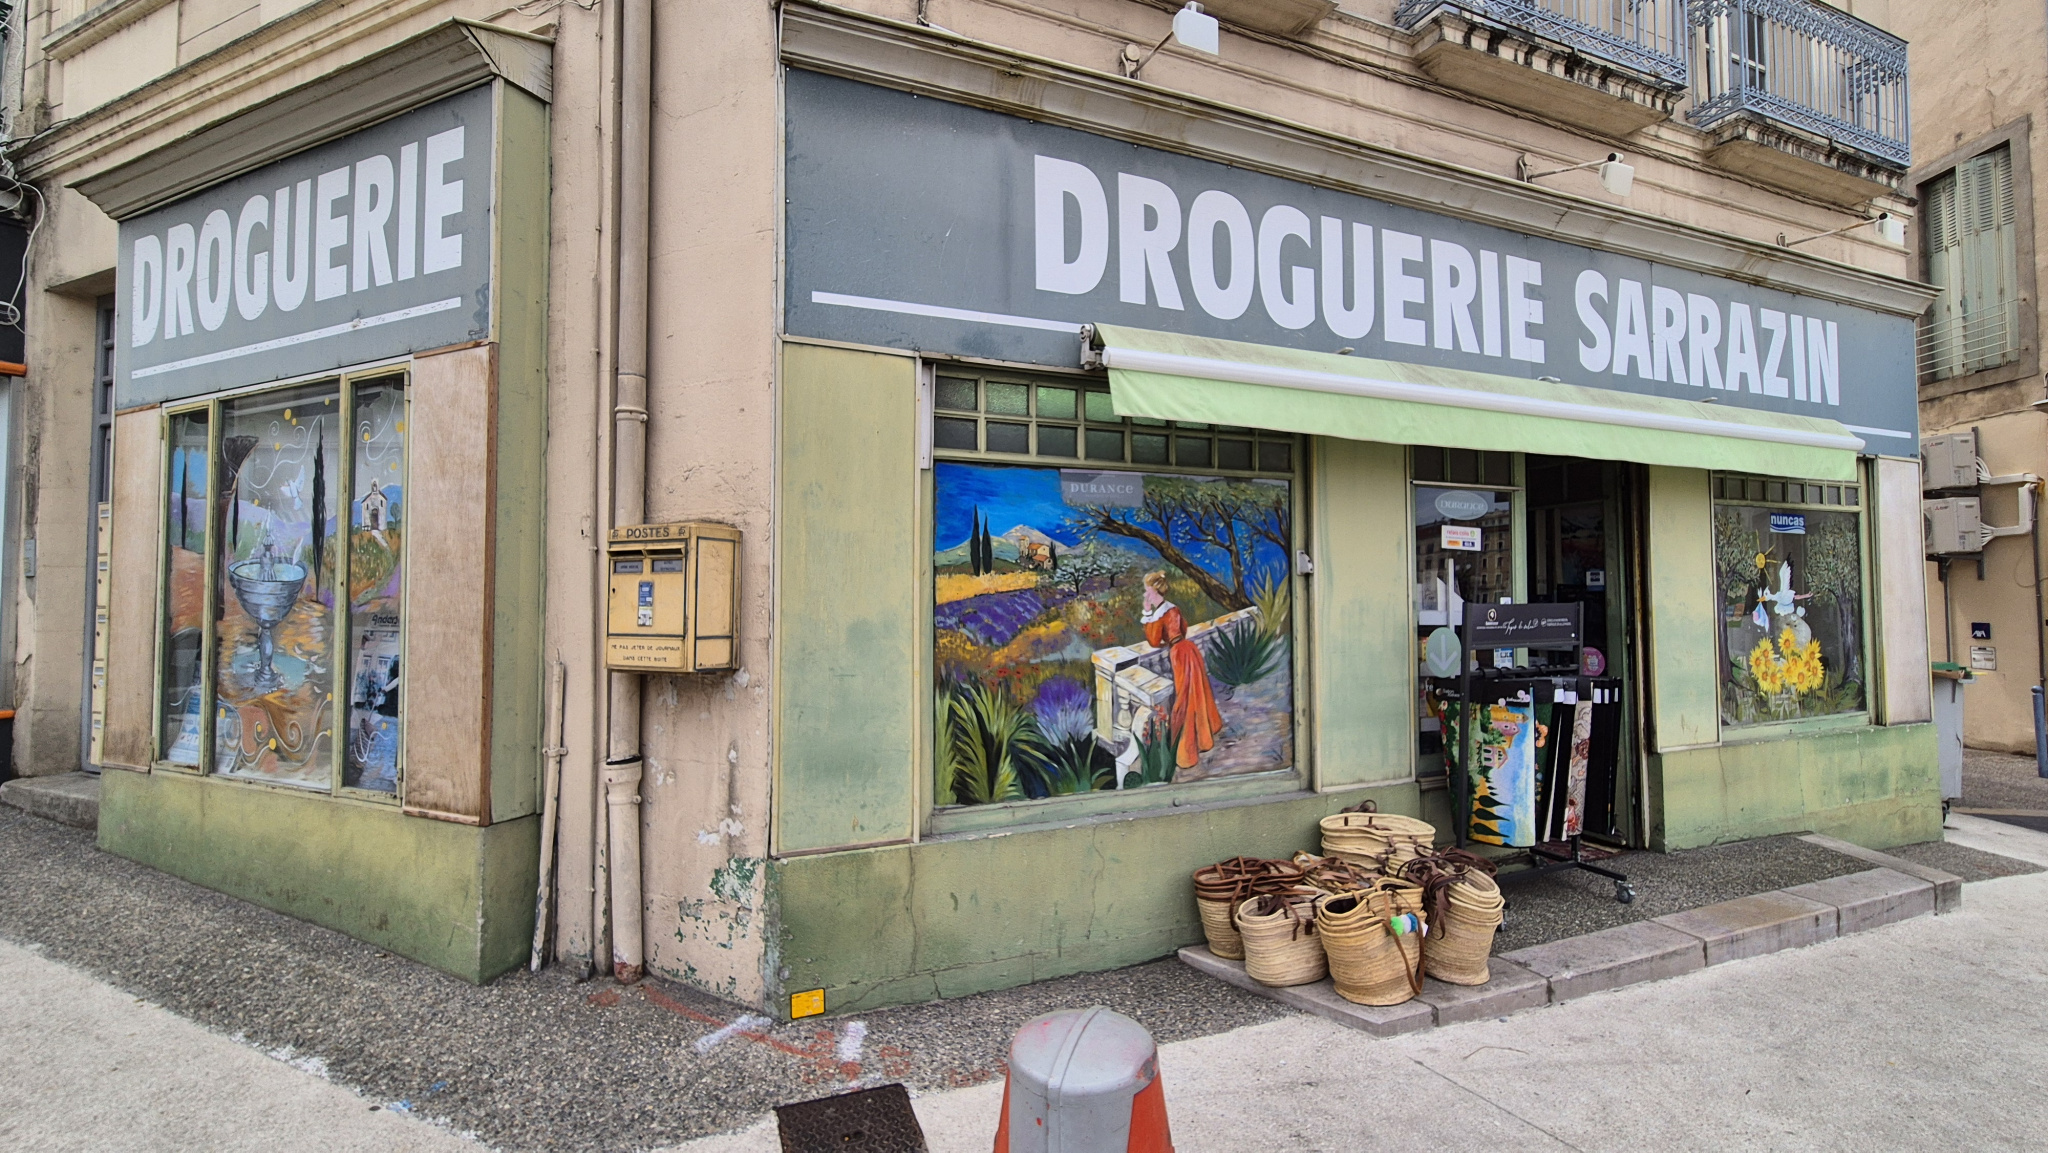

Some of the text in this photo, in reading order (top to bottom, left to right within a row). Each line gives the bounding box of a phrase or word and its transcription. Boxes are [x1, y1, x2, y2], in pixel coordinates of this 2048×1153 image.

[131, 125, 465, 349] DROGUERIE
[1034, 153, 1841, 407] DROGUERIE SARRAZIN
[626, 526, 670, 539] POSTES
[1770, 514, 1805, 527] nuncas
